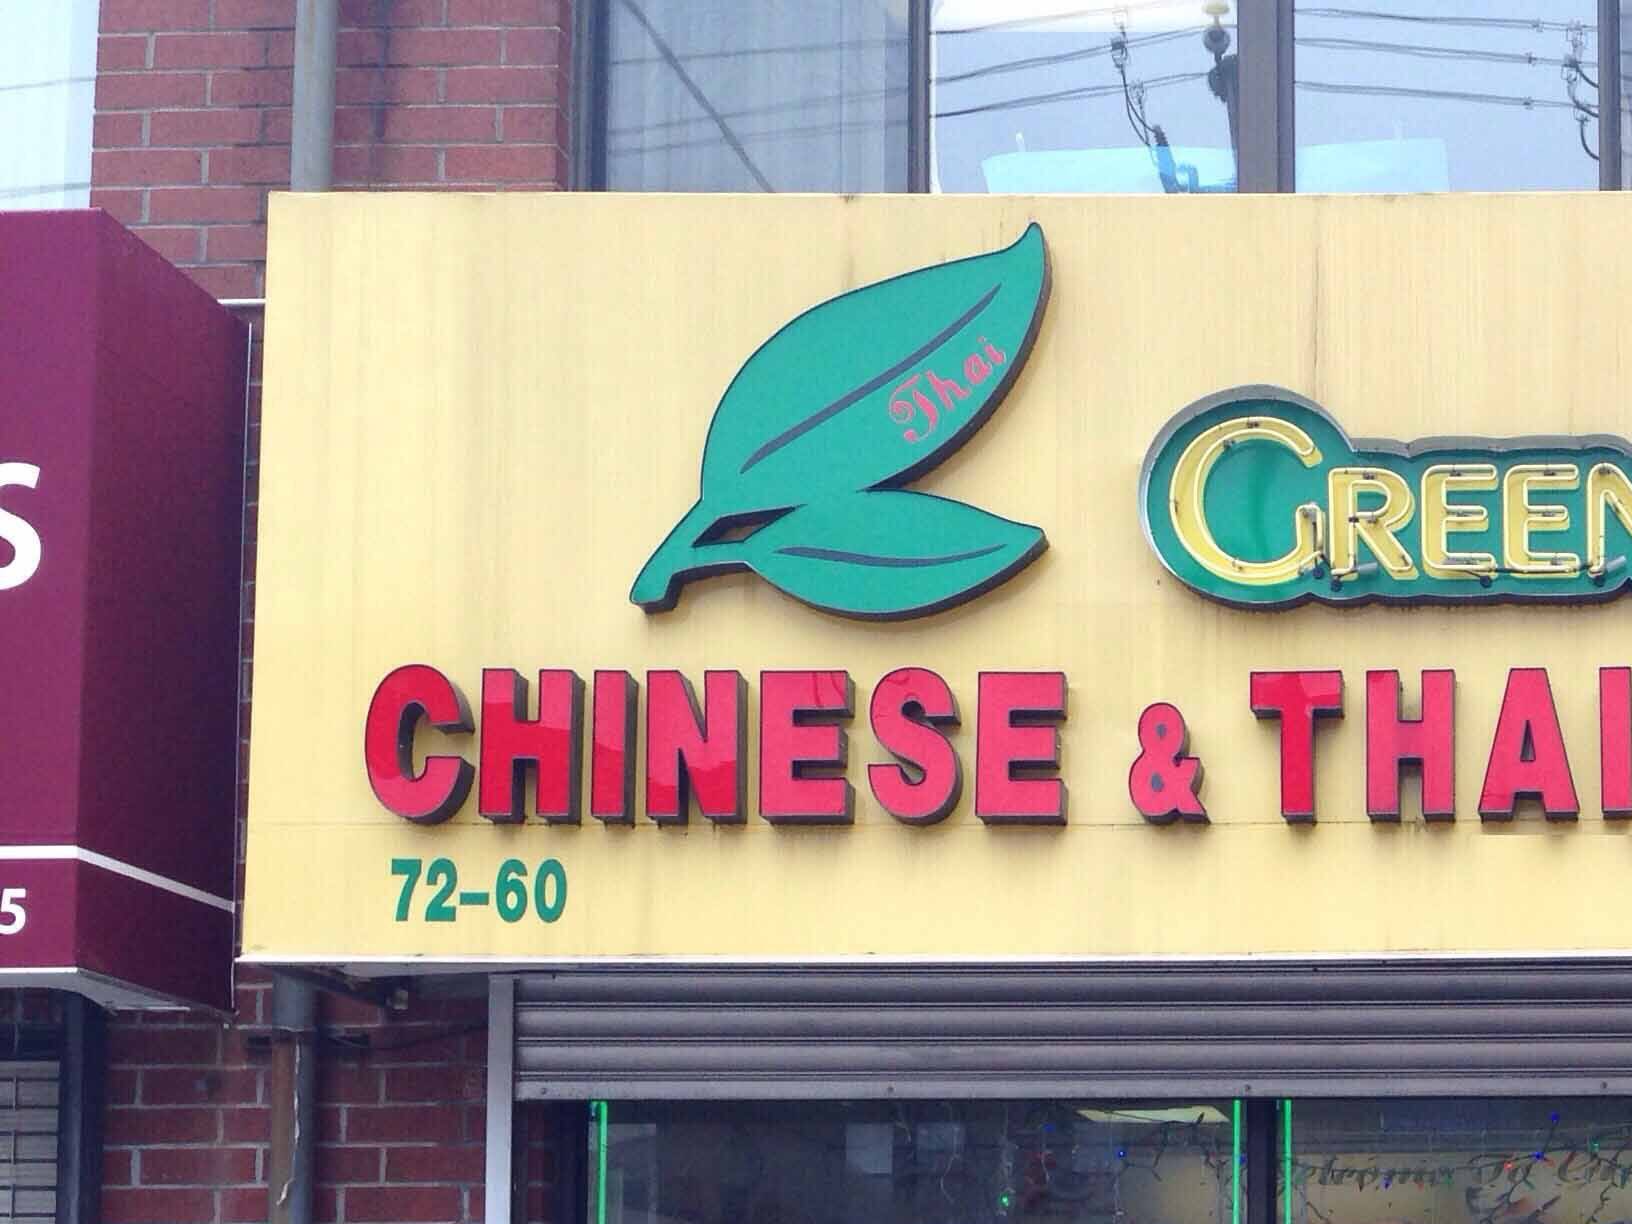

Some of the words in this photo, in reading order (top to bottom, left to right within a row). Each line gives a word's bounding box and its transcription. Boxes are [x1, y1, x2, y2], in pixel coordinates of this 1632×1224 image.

[888, 336, 1007, 442] Thai
[364, 664, 1067, 825] CHINESE
[1129, 701, 1208, 825] &
[389, 859, 567, 923] 72-60
